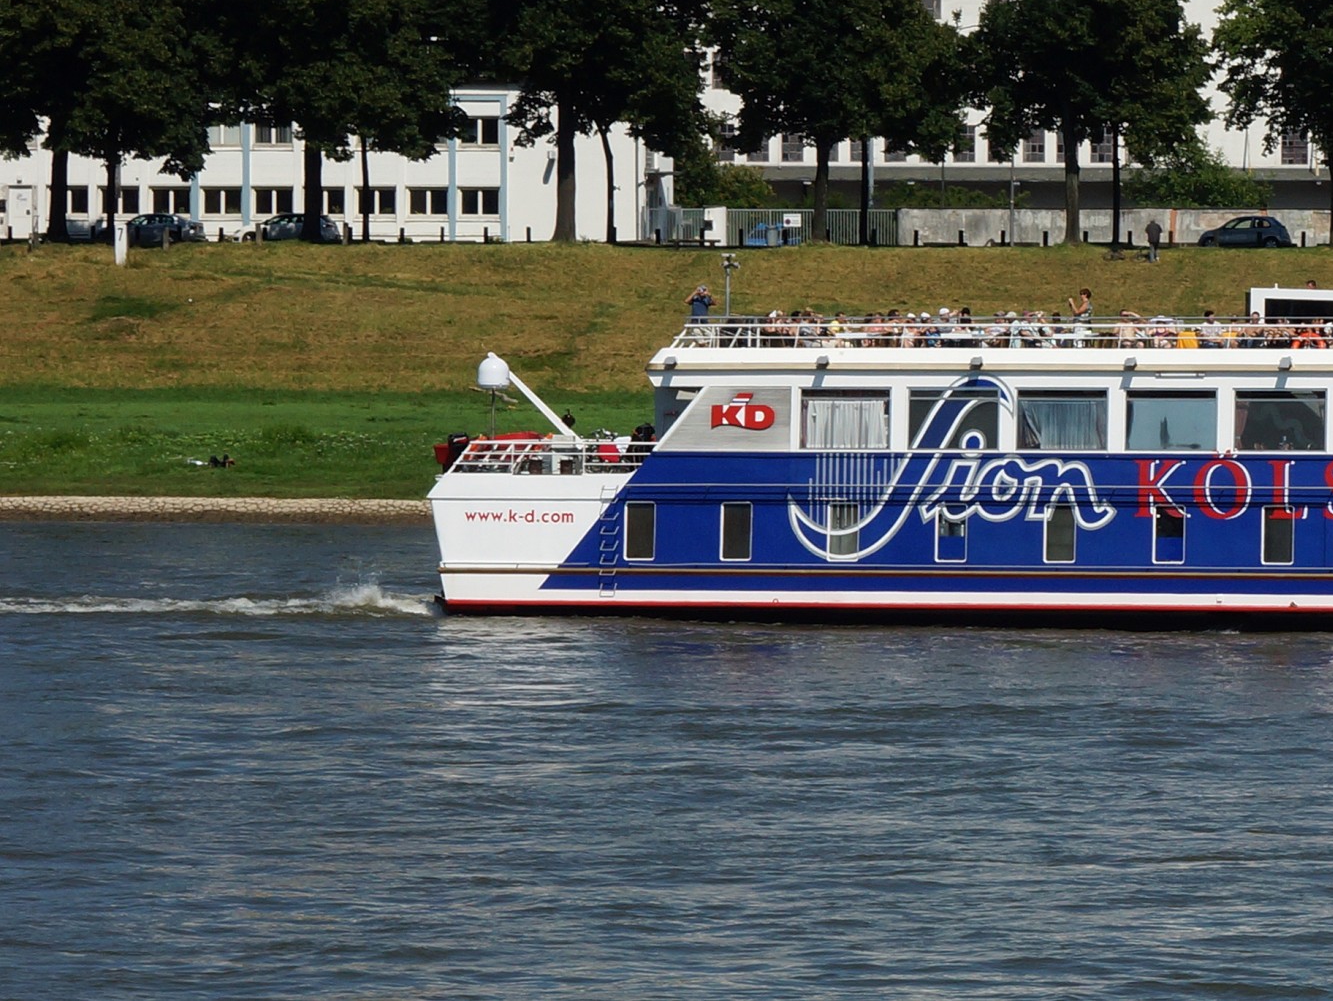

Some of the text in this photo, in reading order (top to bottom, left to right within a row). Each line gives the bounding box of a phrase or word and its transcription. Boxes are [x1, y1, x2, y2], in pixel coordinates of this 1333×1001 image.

[117, 227, 124, 242] 7
[710, 401, 775, 431] KD
[787, 374, 1117, 561] Sion
[464, 509, 575, 523] www.k-d.com
